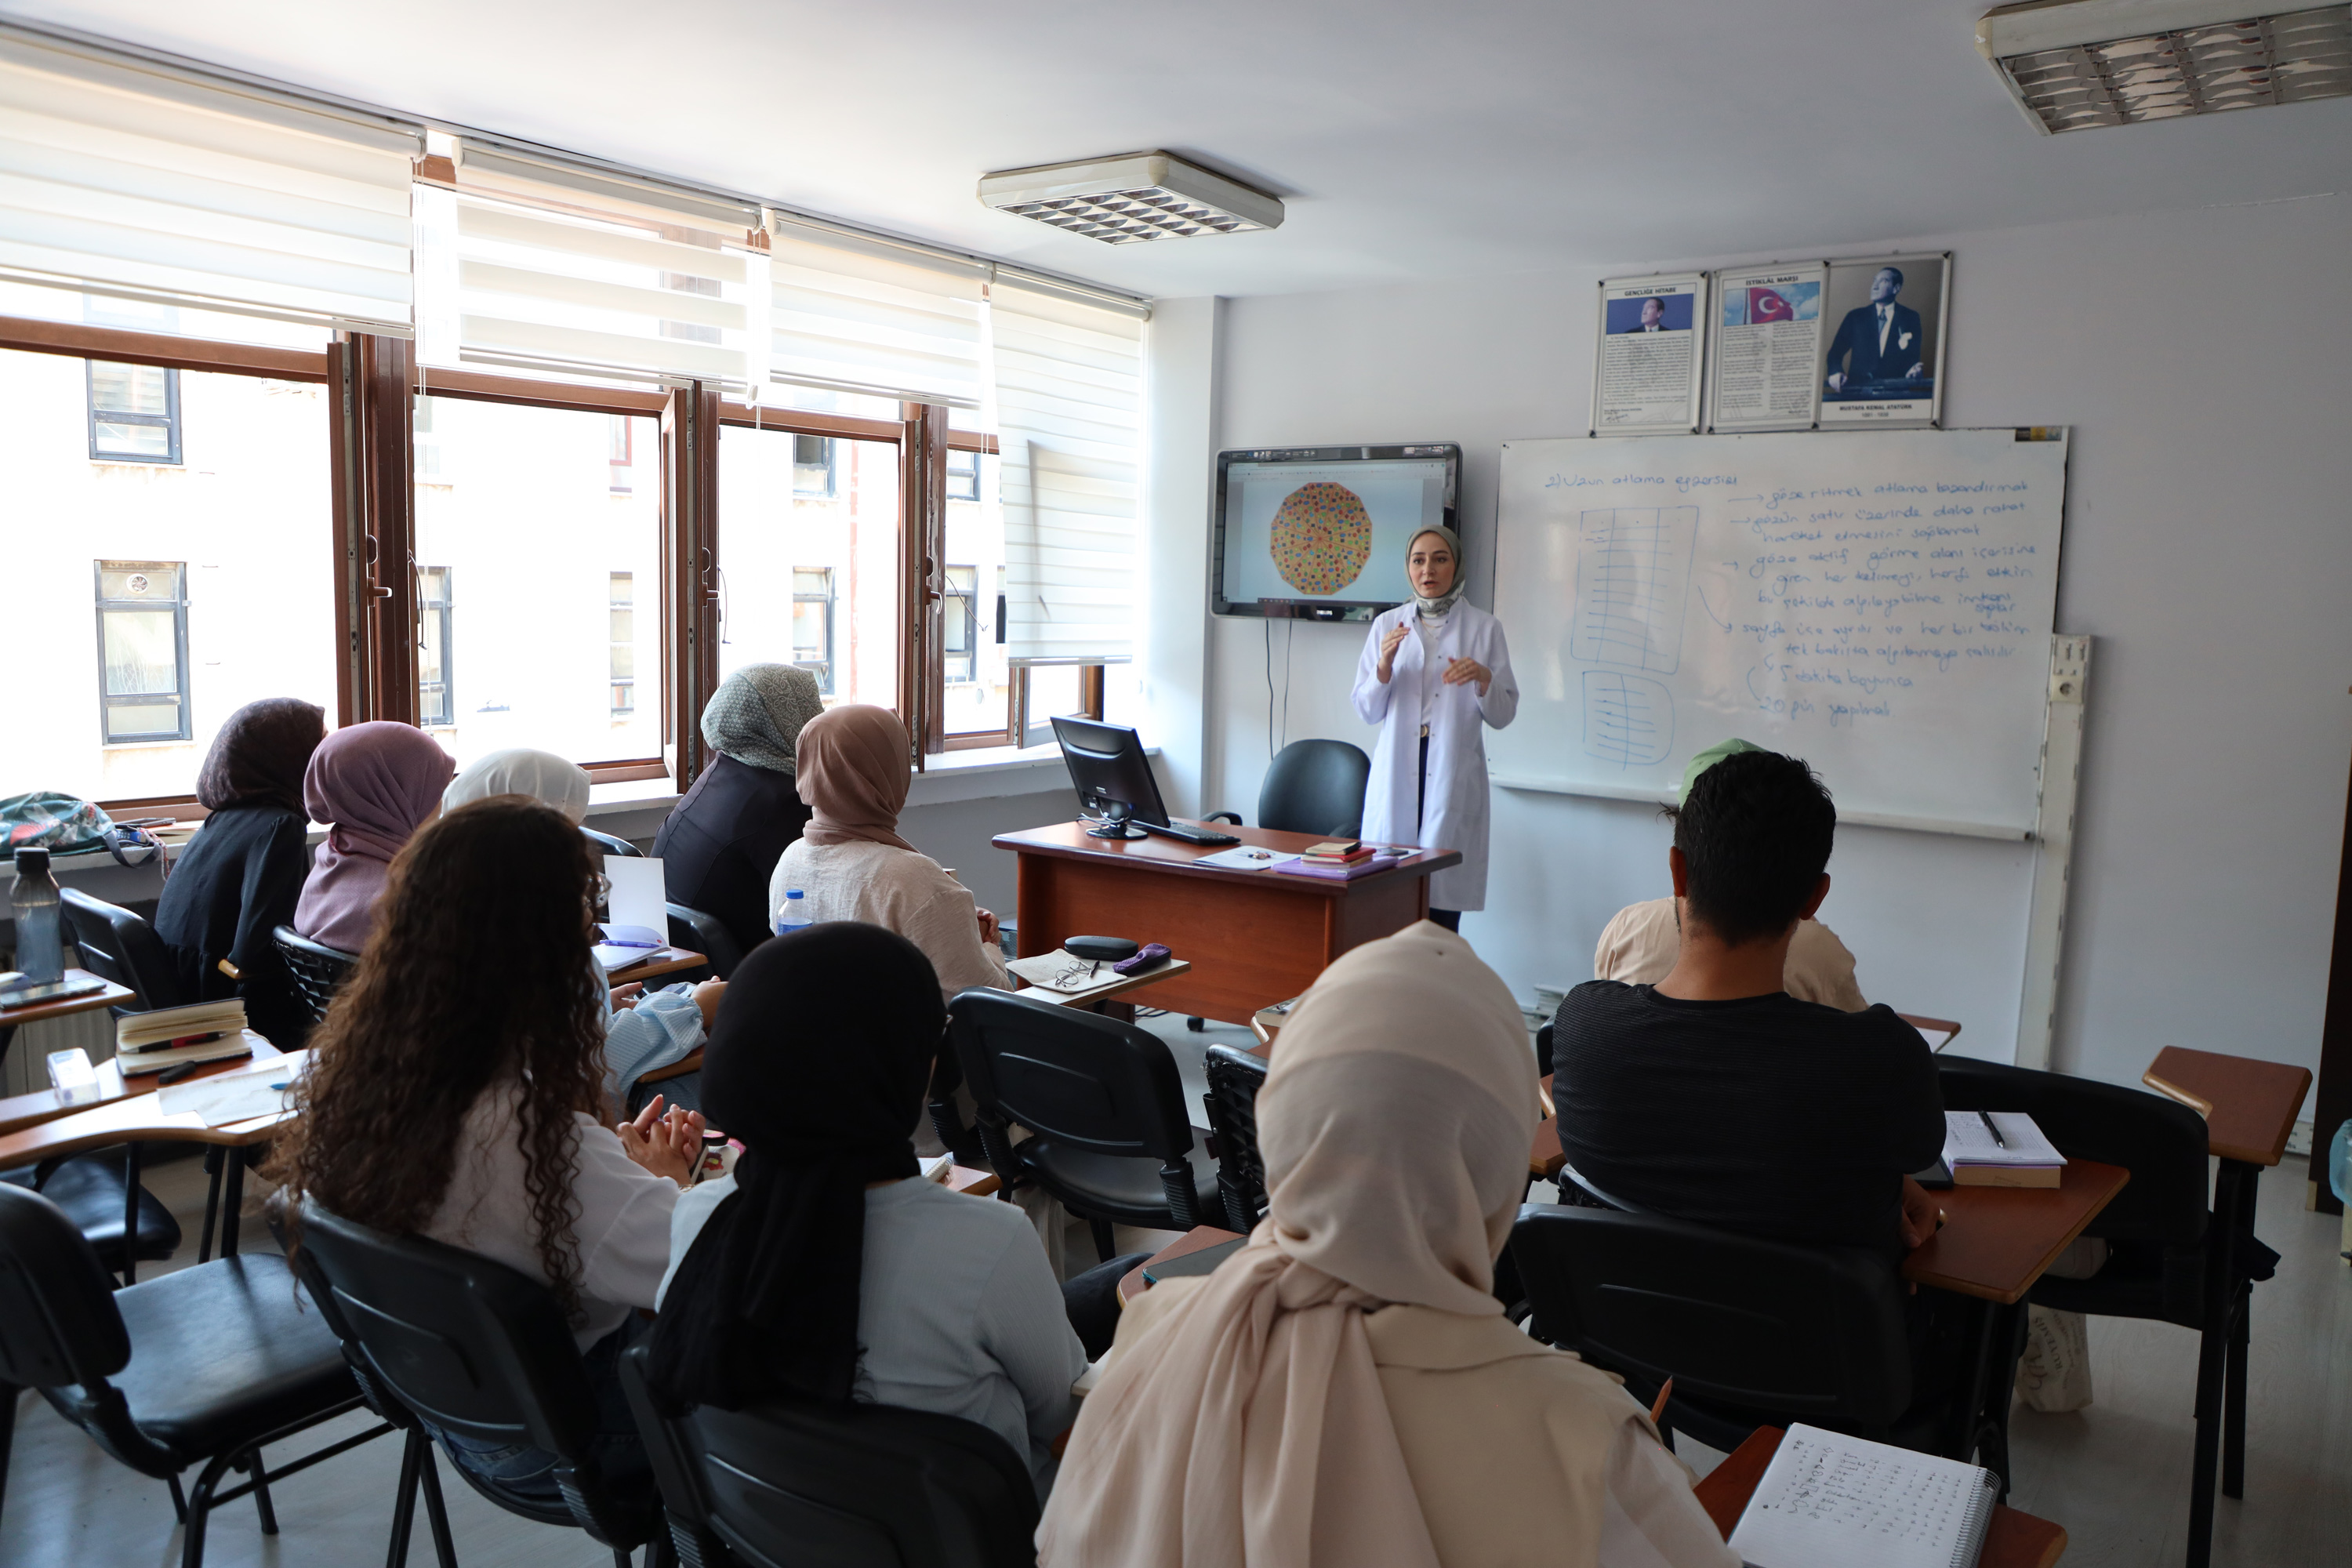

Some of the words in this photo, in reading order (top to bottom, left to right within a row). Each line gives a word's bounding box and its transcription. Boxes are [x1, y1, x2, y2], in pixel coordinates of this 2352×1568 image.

[1612, 474, 1666, 485] atlama
[1874, 482, 1929, 494] atlama
[1933, 504, 1975, 517] daha
[1983, 502, 2026, 515] rahat
